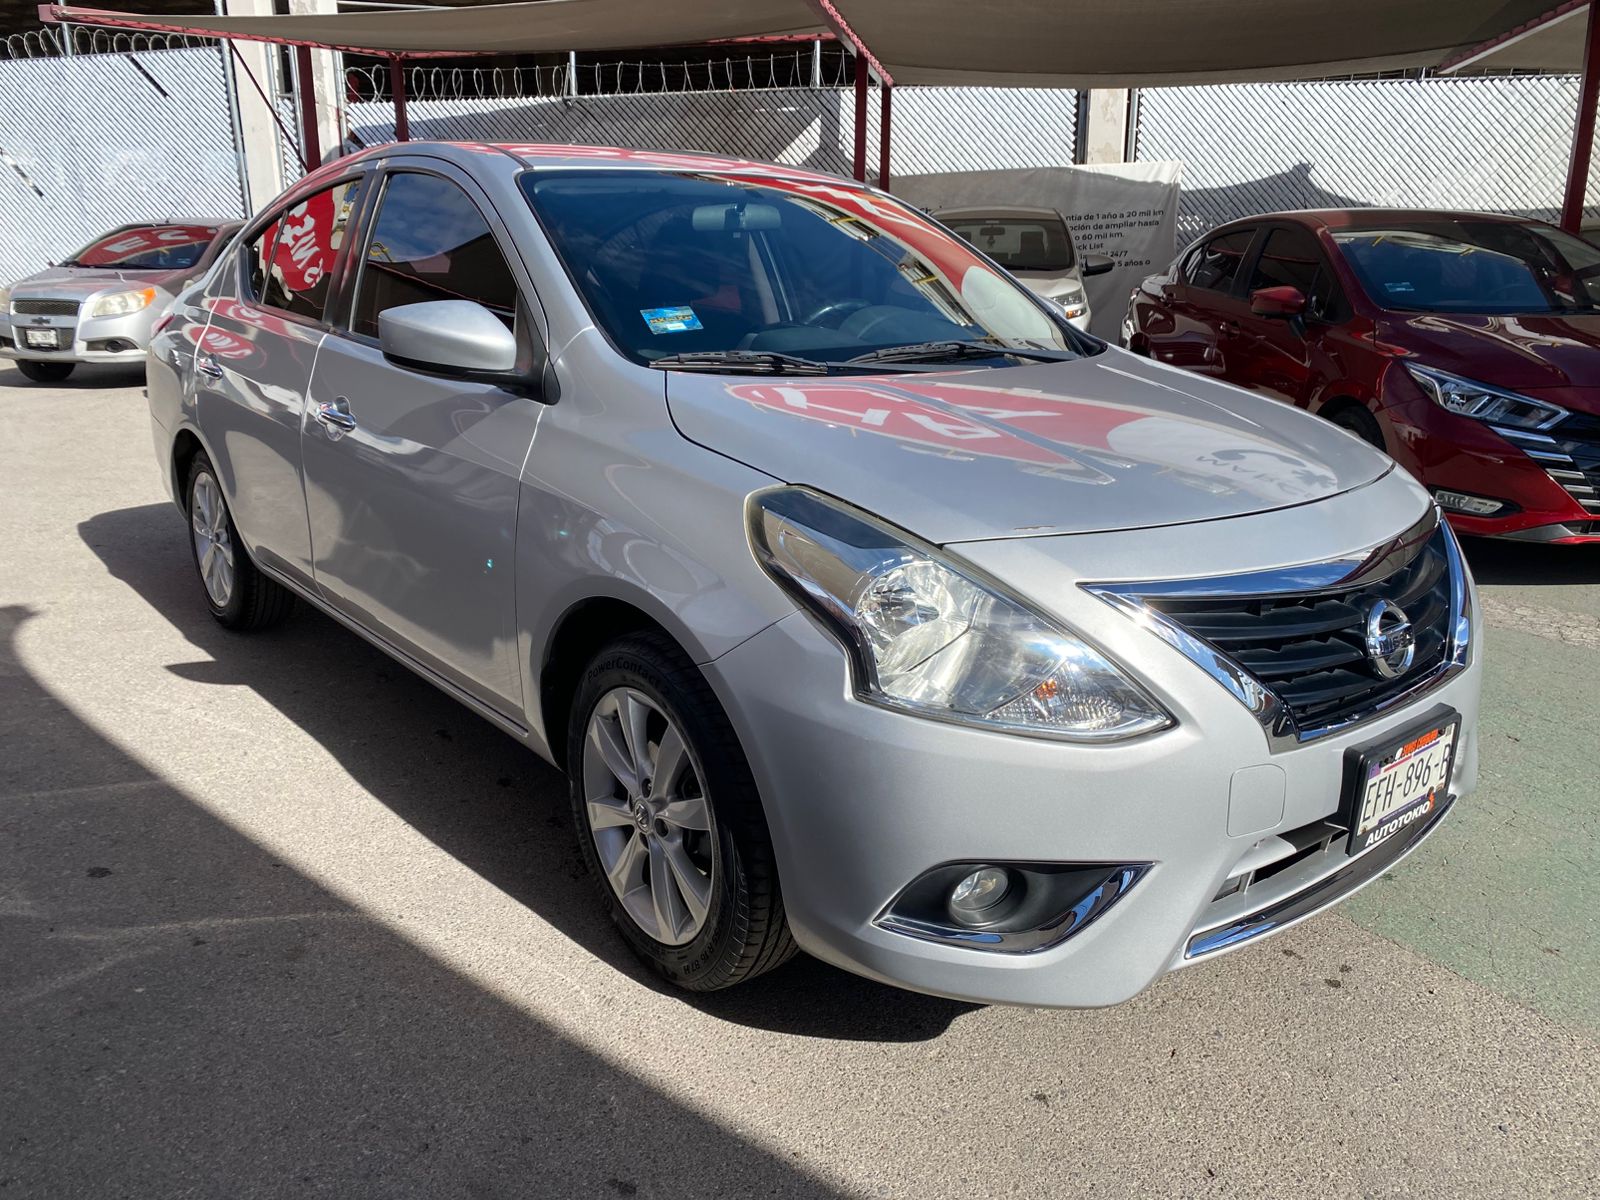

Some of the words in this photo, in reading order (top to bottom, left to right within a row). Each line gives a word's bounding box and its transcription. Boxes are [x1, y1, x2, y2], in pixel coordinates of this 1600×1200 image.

[1083, 213, 1094, 221] de
[1101, 211, 1118, 220] año
[1126, 210, 1137, 218] 20
[1138, 209, 1152, 217] mil
[1104, 221, 1137, 230] ampliar
[1081, 233, 1093, 241] 60
[1094, 232, 1108, 240] mil
[1089, 242, 1104, 250] List
[1110, 250, 1128, 258] 24/7
[1124, 259, 1144, 267] años
[1365, 800, 1431, 847] AUTOTOKIO
